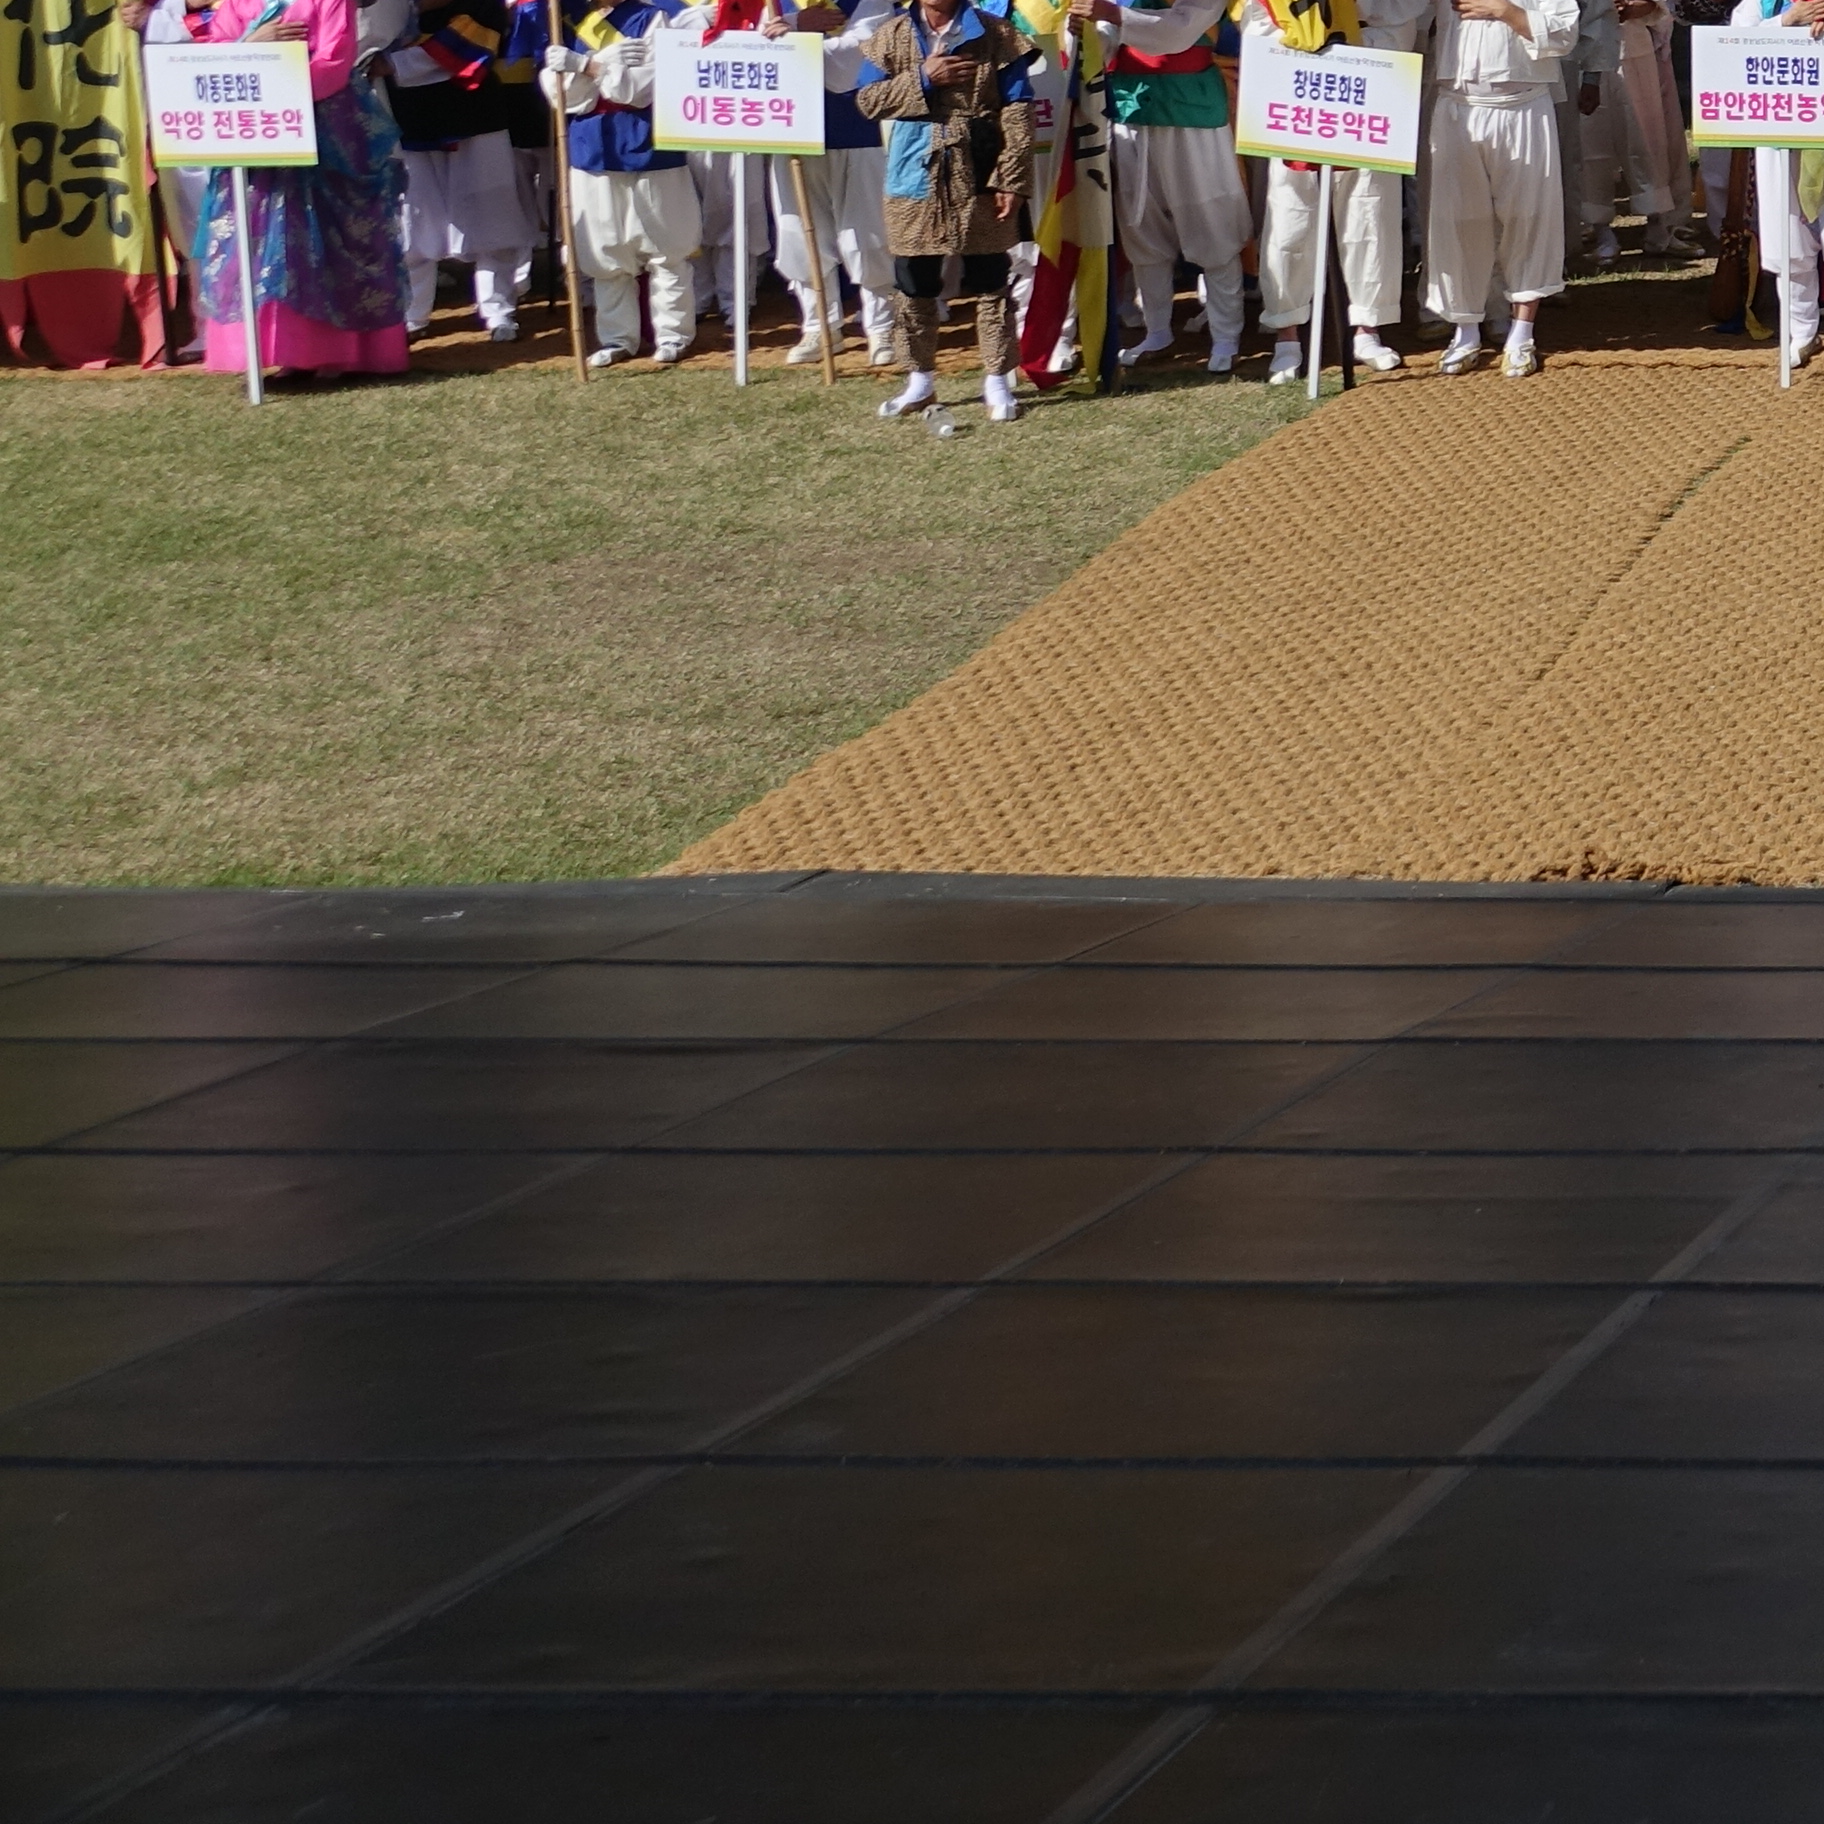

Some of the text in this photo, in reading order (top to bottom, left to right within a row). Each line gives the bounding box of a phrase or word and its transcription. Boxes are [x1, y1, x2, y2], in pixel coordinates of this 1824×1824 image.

[697, 60, 779, 91] 남해문화원
[1293, 68, 1367, 106] 창녕문화원
[1745, 56, 1820, 85] 함안문화원
[161, 108, 304, 141] 악양 전통농악
[682, 94, 795, 127] 이동농악
[1266, 101, 1391, 145] 도천농악단
